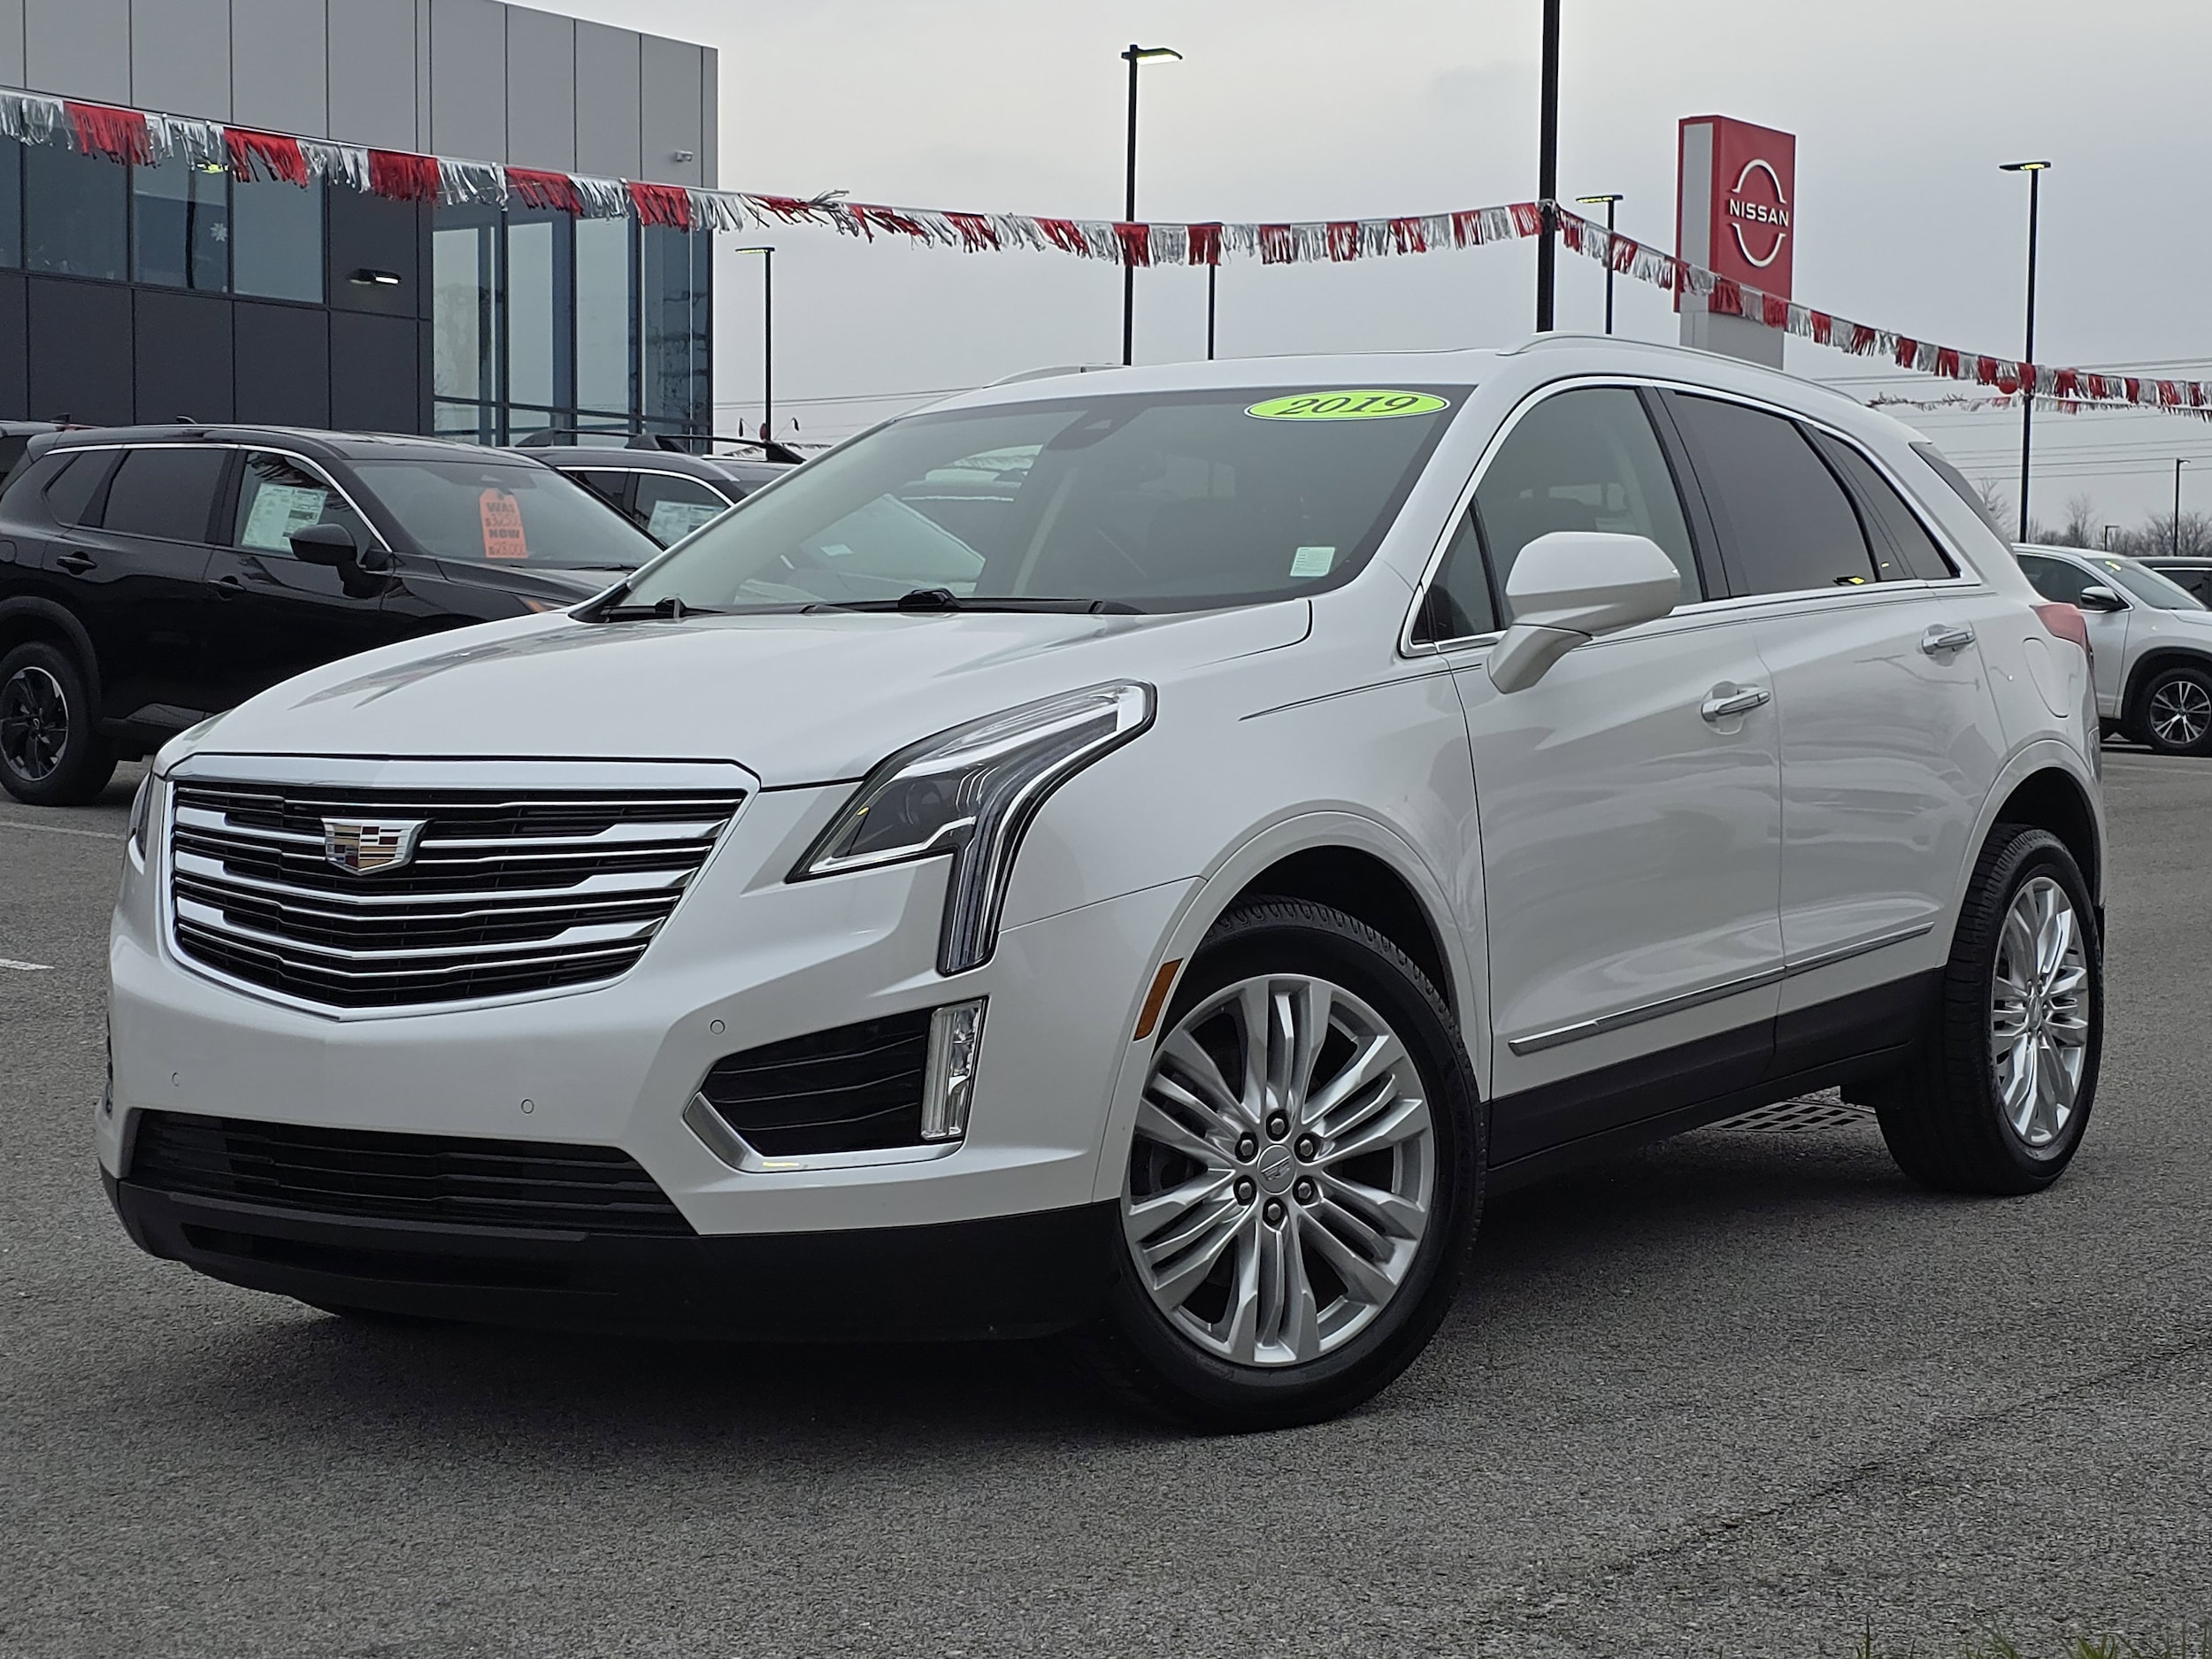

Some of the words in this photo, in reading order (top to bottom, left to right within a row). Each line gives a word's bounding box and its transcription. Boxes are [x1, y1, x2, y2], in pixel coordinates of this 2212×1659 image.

[1729, 198, 1789, 227] NISSAN
[1273, 396, 1419, 416] 2019
[487, 502, 516, 513] WAS
[489, 529, 520, 539] NOW
